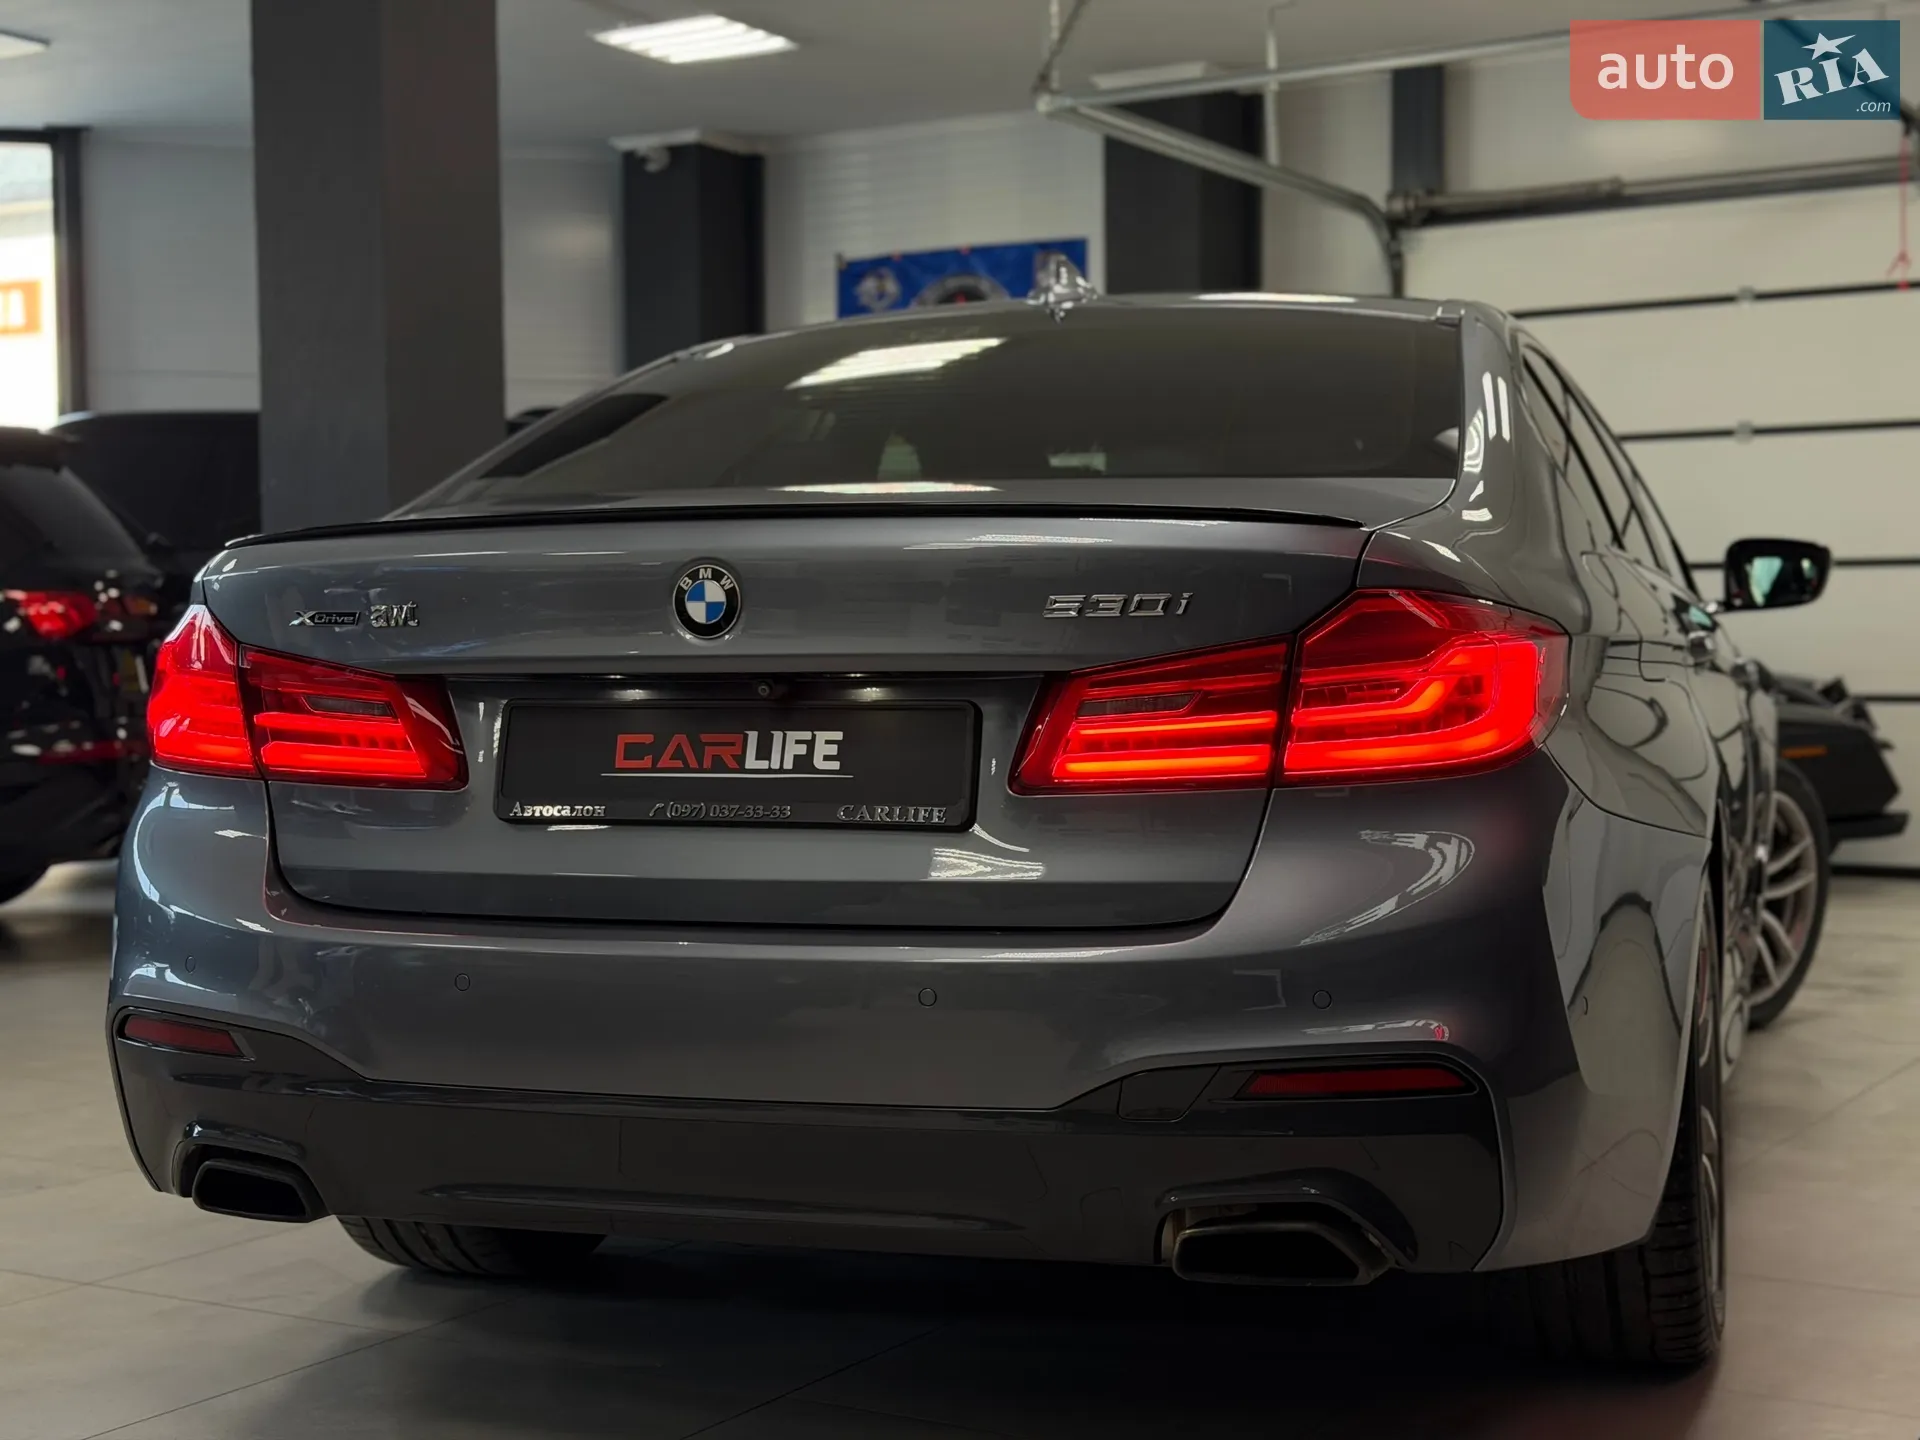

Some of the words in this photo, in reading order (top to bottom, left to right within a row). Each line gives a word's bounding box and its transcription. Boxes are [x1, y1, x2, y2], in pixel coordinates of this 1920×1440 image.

[680, 567, 734, 591] BMW
[1042, 592, 1194, 618] 530i
[613, 730, 844, 770] CARLIFE
[509, 801, 606, 818] Автосалон
[666, 801, 706, 819] (097)
[709, 803, 791, 820] 037-33-33
[836, 804, 947, 824] CARLIFE
